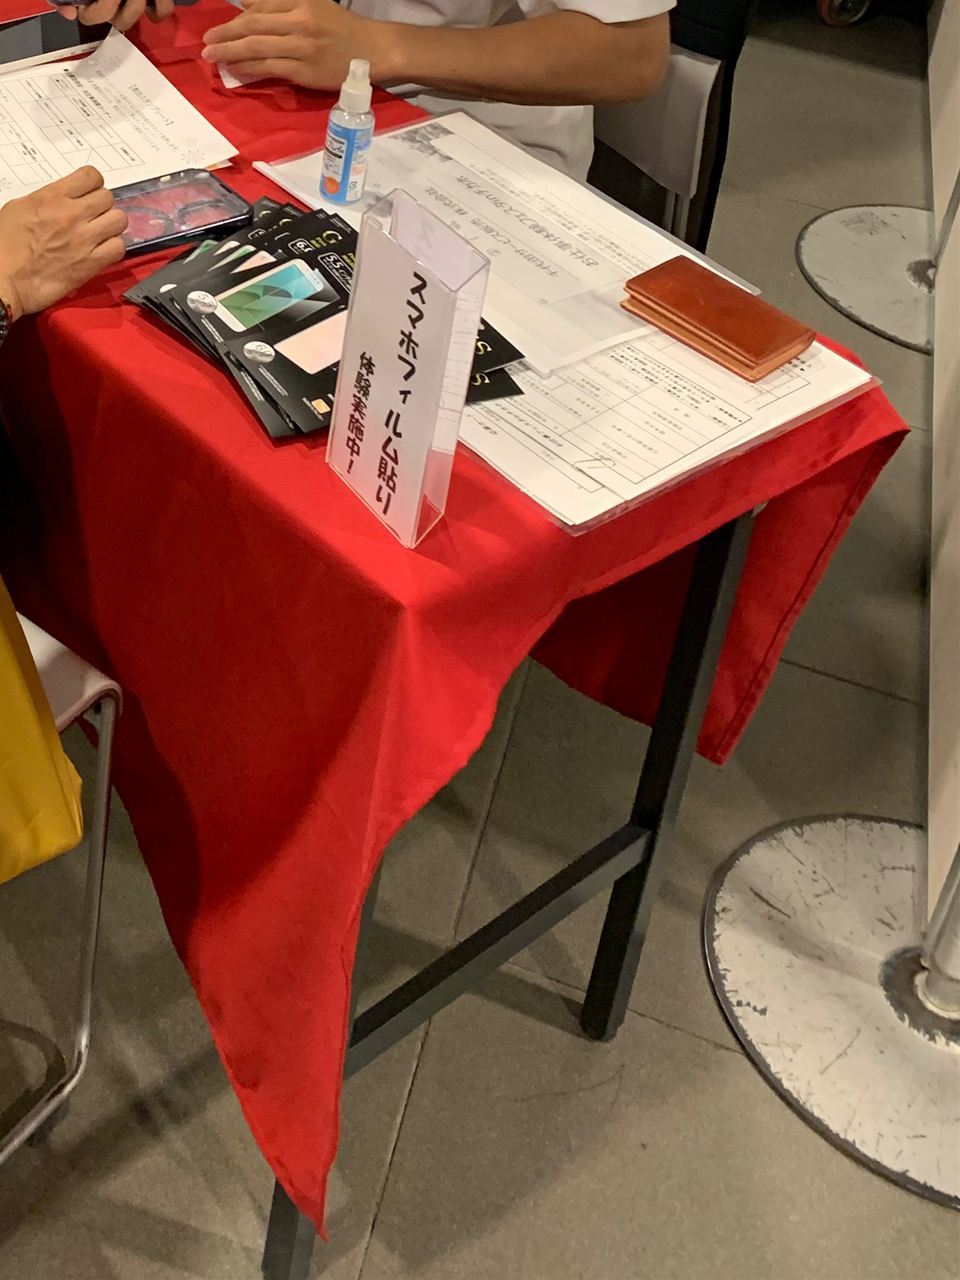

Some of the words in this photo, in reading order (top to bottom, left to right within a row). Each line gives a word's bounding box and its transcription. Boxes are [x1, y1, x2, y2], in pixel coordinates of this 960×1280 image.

[375, 271, 428, 516] スマホフィルム貼り
